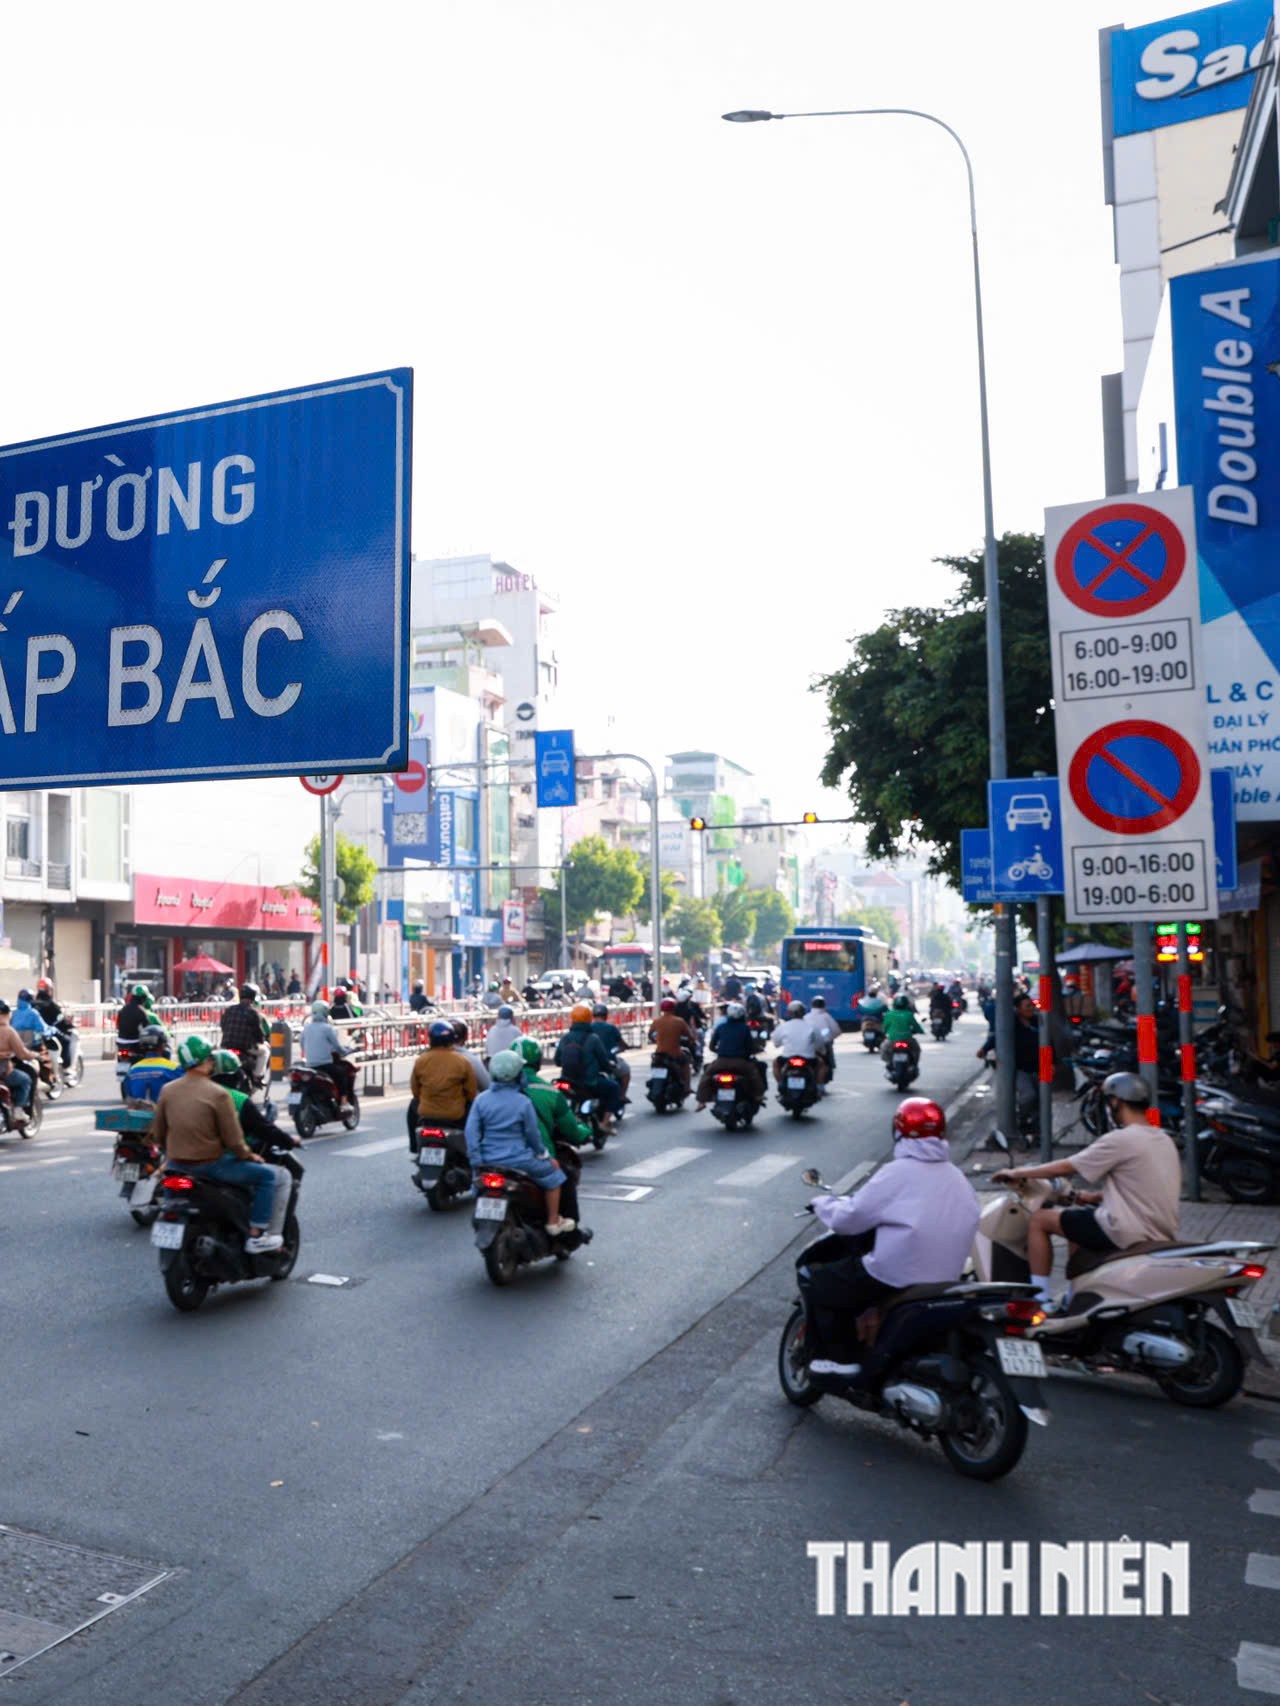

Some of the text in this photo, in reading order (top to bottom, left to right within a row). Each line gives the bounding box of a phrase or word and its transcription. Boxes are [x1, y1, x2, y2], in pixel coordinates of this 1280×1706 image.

[1200, 287, 1259, 528] Double A
[8, 453, 255, 557] ĐƯỜNG
[495, 574, 538, 593] HOTEL
[107, 558, 305, 729] BẮC
[1074, 631, 1177, 660] 6:00-9:00
[1067, 660, 1188, 692] 16:00-19:00
[1206, 680, 1274, 703] L & C
[1208, 738, 1243, 754] HÂN
[1082, 852, 1195, 877] 9:00-16:00
[1083, 883, 1195, 906] 19:00-6:00
